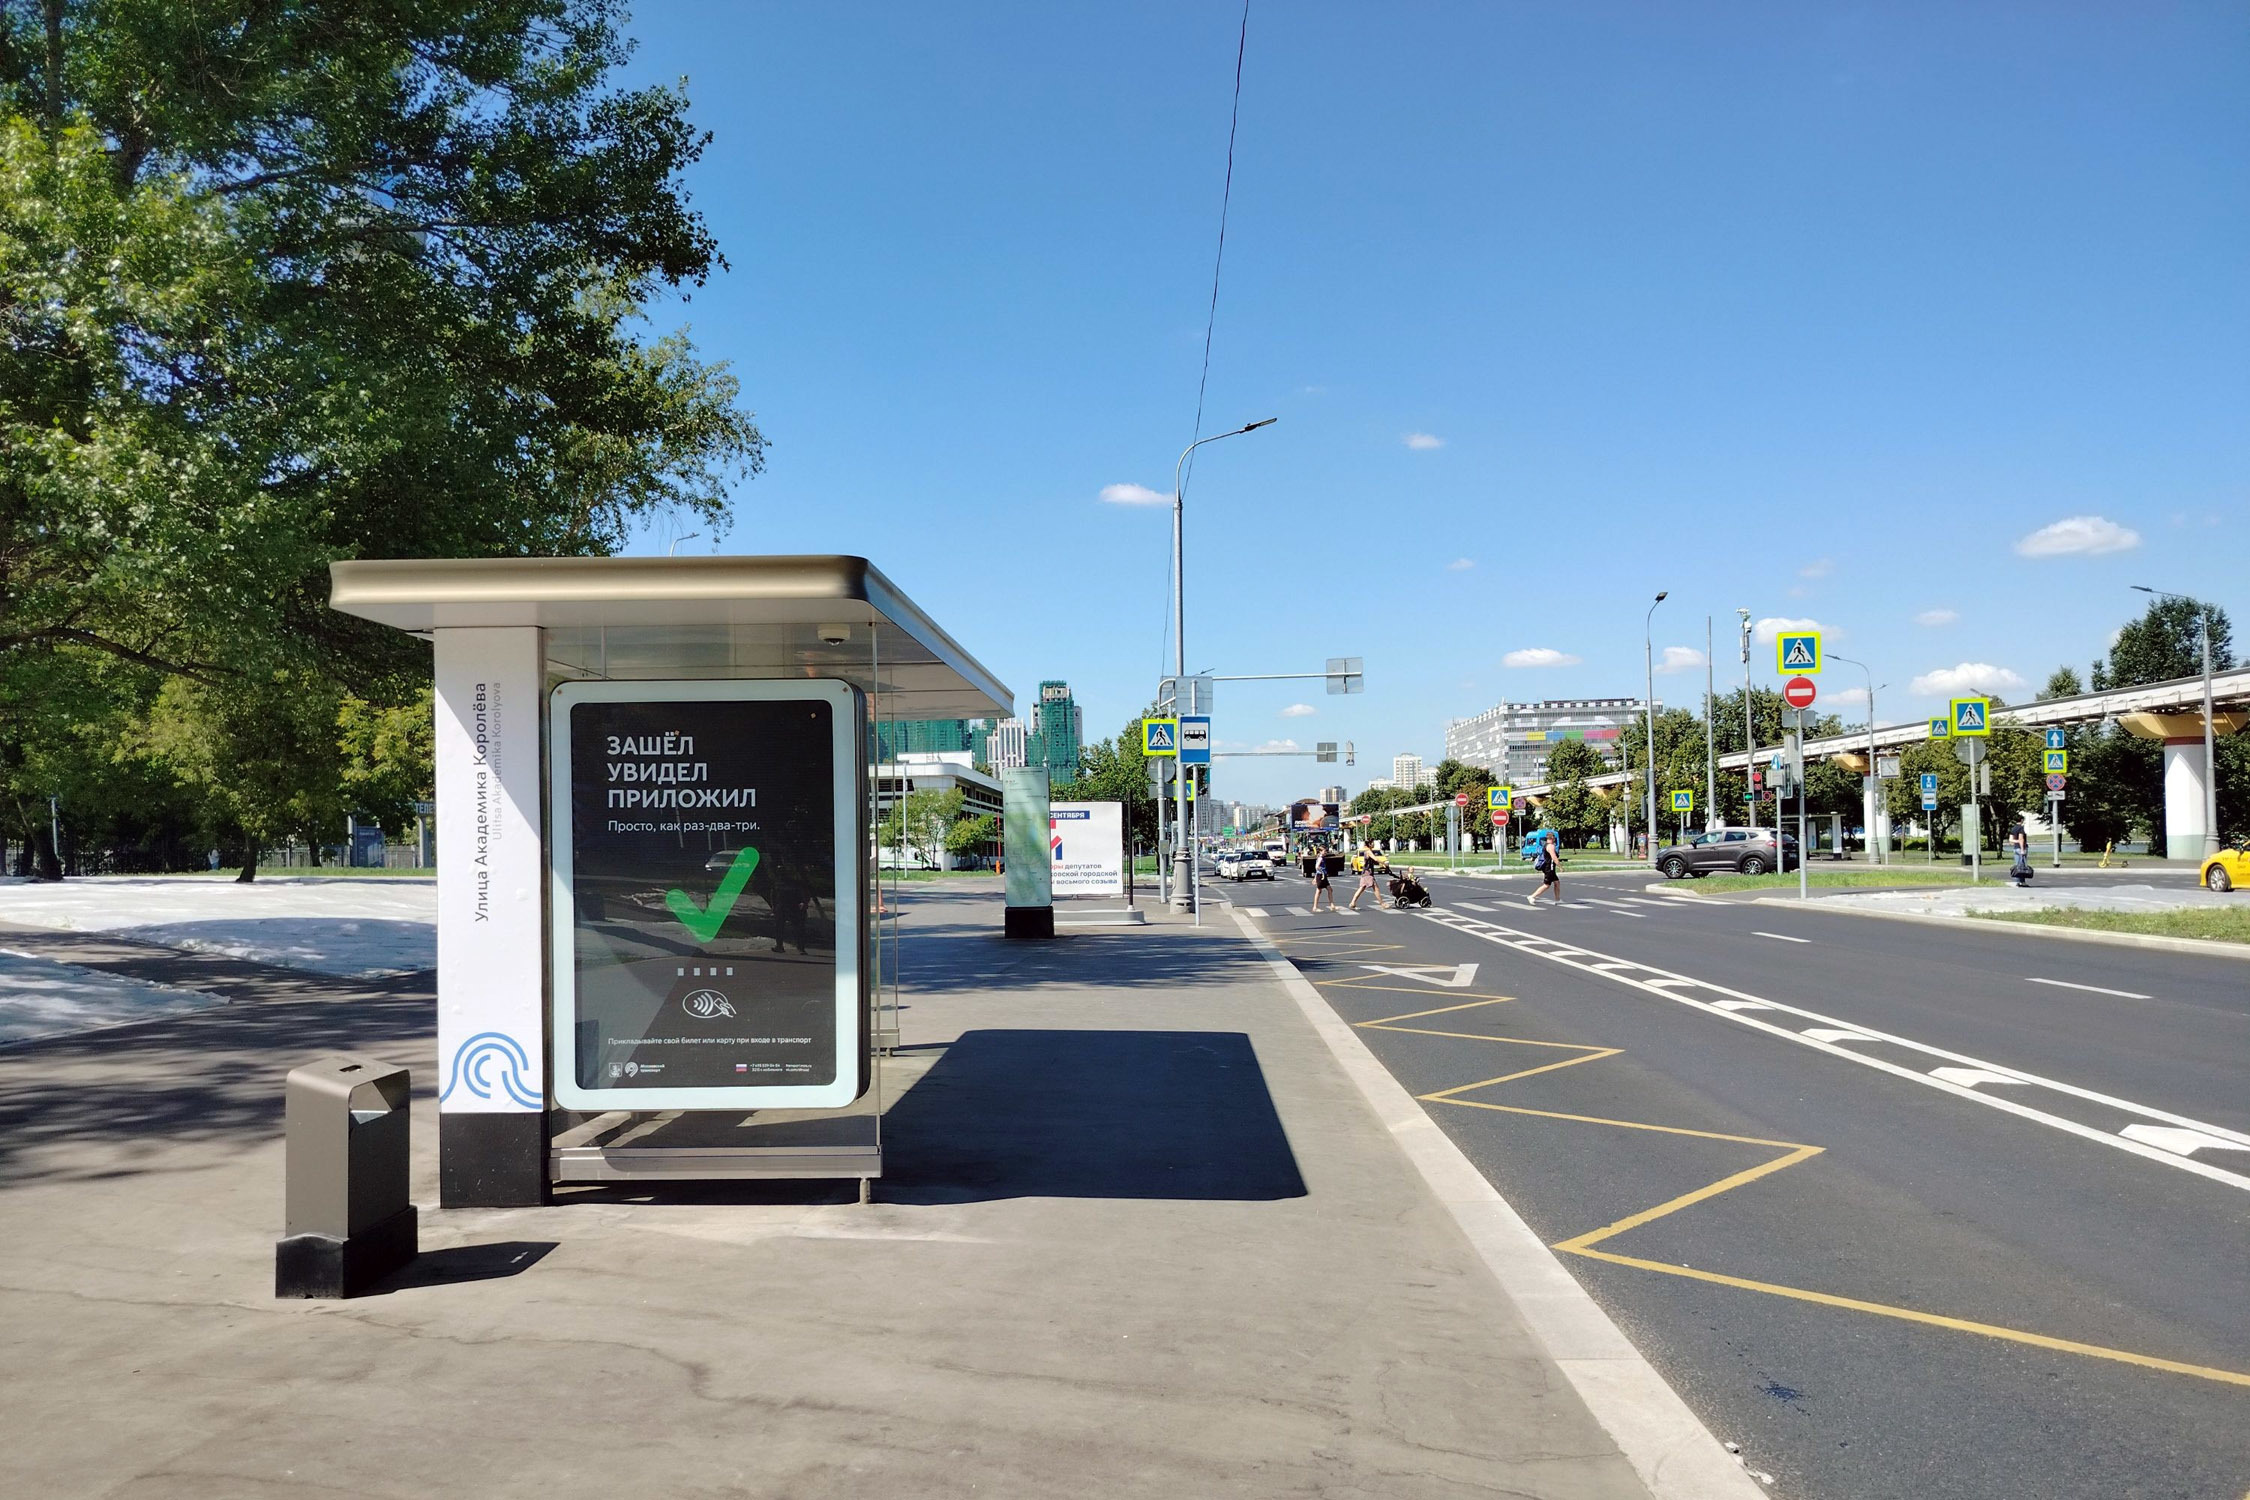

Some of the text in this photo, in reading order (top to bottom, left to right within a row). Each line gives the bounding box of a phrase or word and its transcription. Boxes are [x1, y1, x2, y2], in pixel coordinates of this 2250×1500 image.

[606, 731, 694, 756] ЗАШЁЛ
[491, 682, 504, 841] Ulitsa Akademika Korolyova
[606, 762, 708, 785] УВИДЕЛ
[472, 682, 490, 922] Улица Академика Королёва
[607, 788, 757, 809] ПРИЛОЖИЛ
[607, 820, 761, 833] Просто, как раз-два-три.
[1065, 863, 1102, 871] депутатов
[1079, 870, 1118, 878] городской
[607, 1037, 662, 1046] Прикладывайте
[663, 1036, 680, 1045] свой
[681, 1036, 701, 1045] билет
[716, 1037, 735, 1045] карту
[736, 1037, 750, 1045] при
[750, 1037, 771, 1045] входе
[777, 1036, 812, 1045] транспорт
